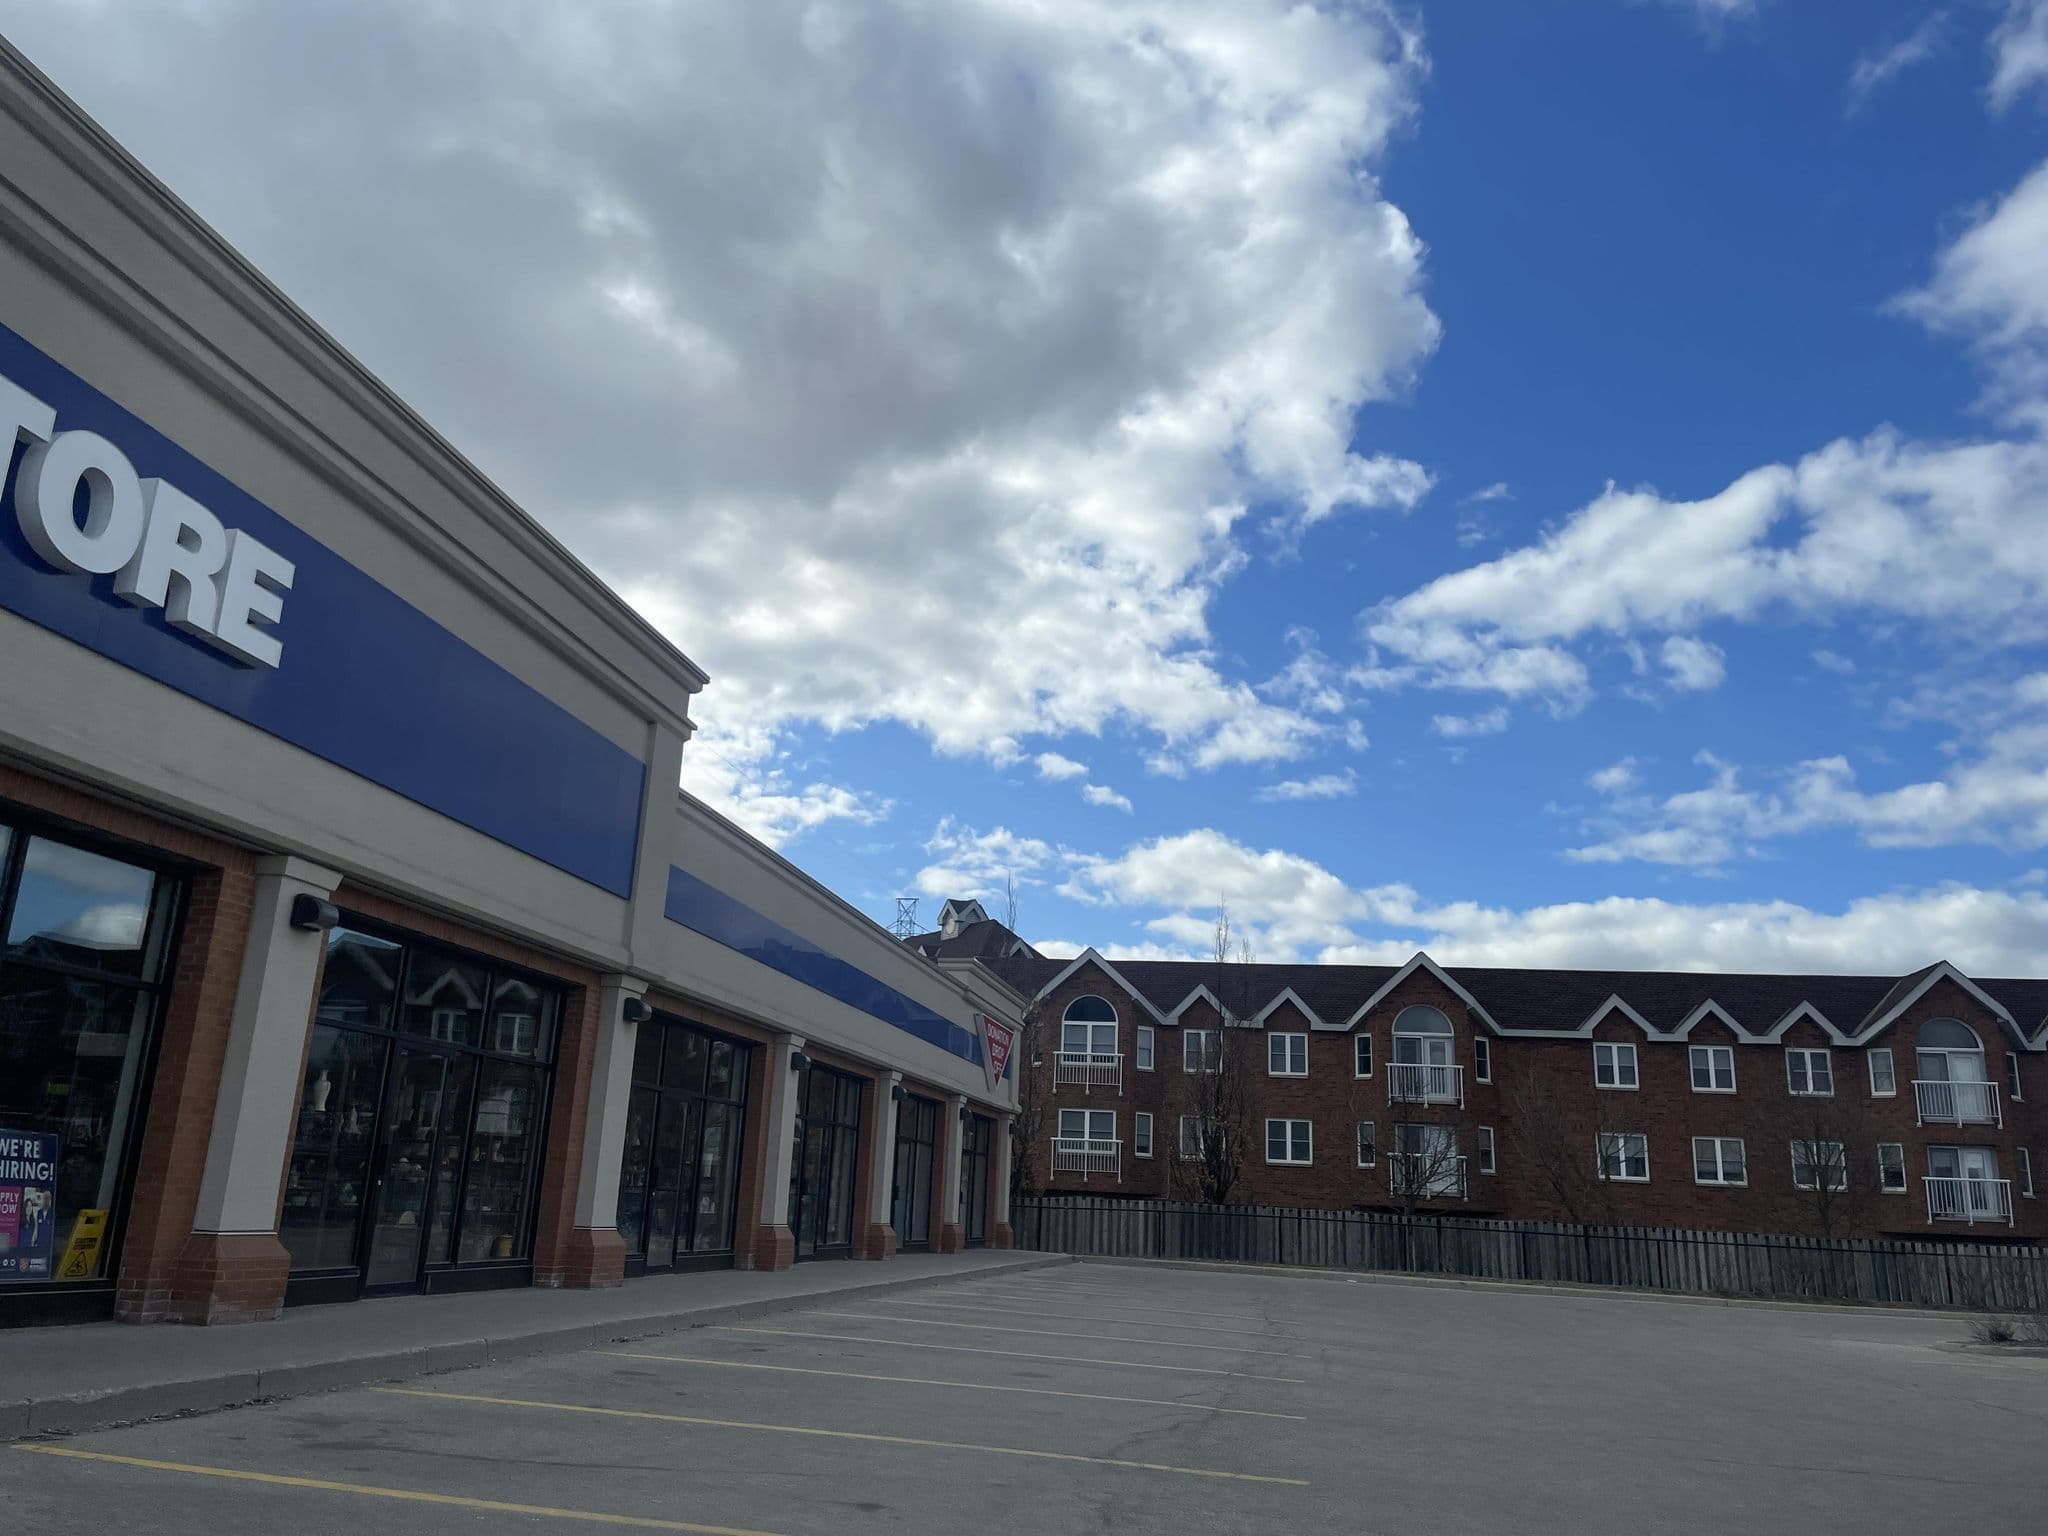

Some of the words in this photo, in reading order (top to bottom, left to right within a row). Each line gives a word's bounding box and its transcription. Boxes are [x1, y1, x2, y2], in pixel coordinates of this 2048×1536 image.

[987, 1023, 1008, 1046] DONATION
[992, 1043, 1004, 1058] DROP
[0, 1138, 40, 1158] WE'RE
[0, 1191, 20, 1203] PPLY
[0, 1204, 17, 1214] OW
